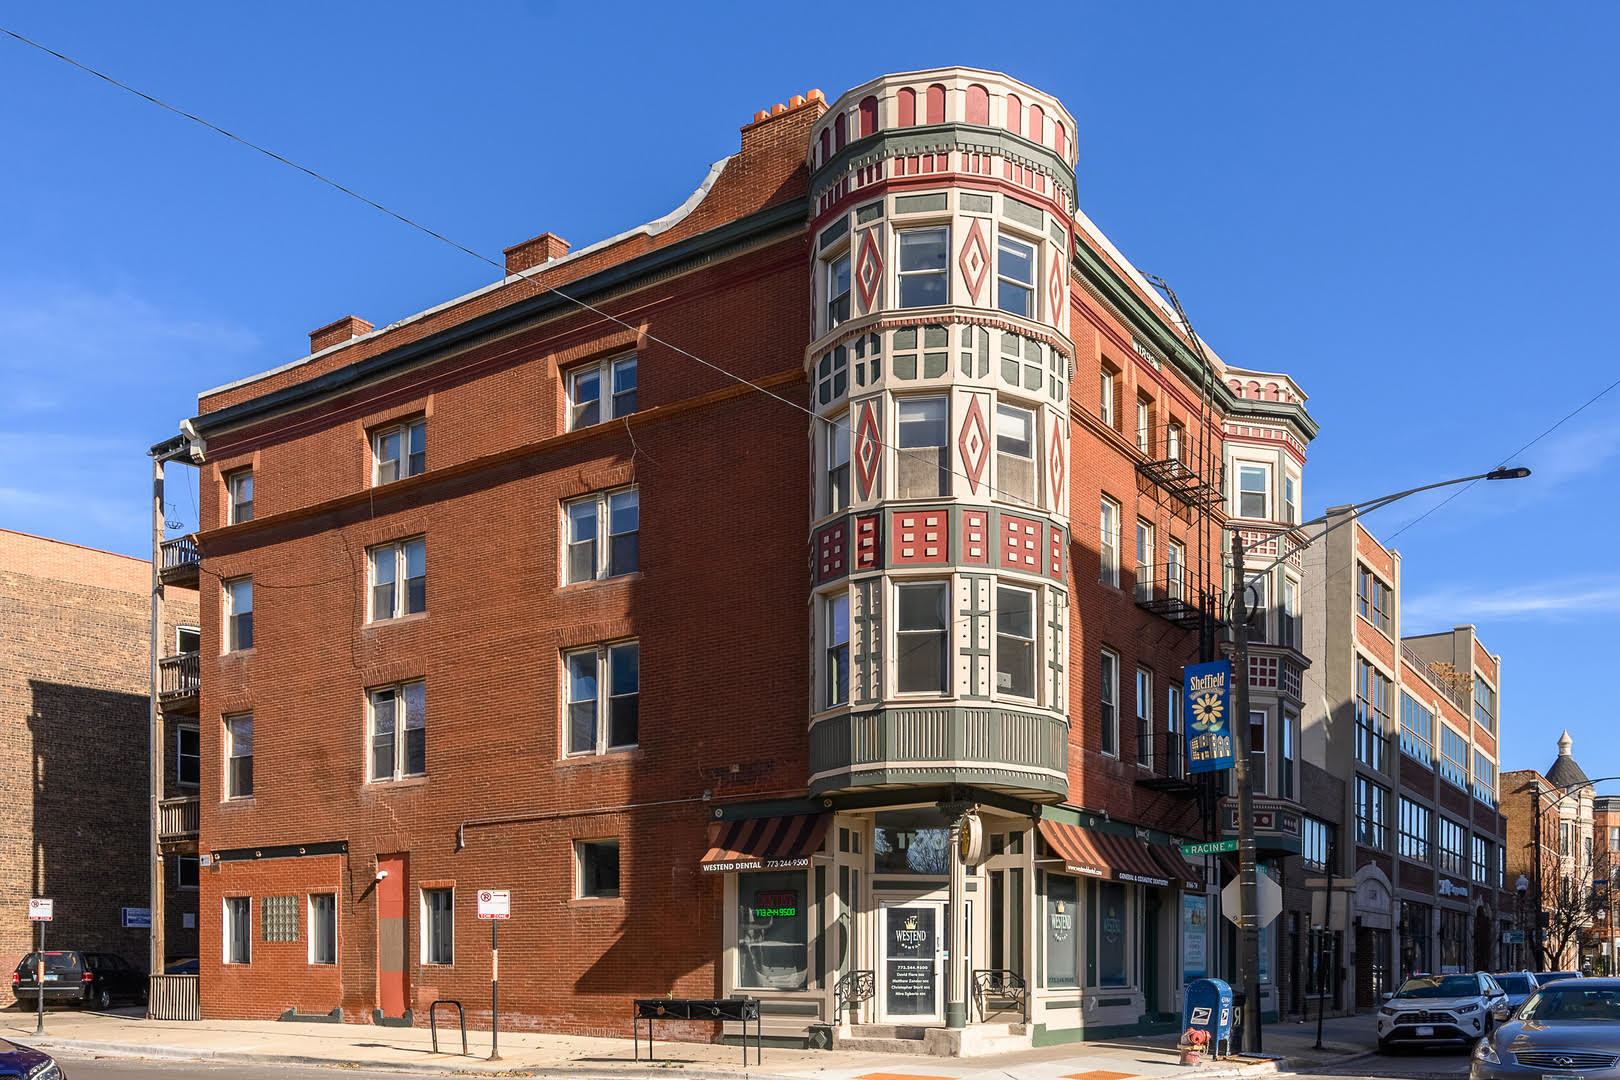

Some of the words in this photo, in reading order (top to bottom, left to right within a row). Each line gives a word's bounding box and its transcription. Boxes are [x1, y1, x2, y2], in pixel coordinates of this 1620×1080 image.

[1190, 672, 1225, 691] Sheffield
[1191, 842, 1225, 854] RACINE
[703, 862, 734, 871] WESTEND
[735, 861, 762, 870] DENTAL
[766, 859, 809, 867] 773-244-9500
[1050, 913, 1072, 934] WESTEND
[895, 930, 927, 944] WESTEND
